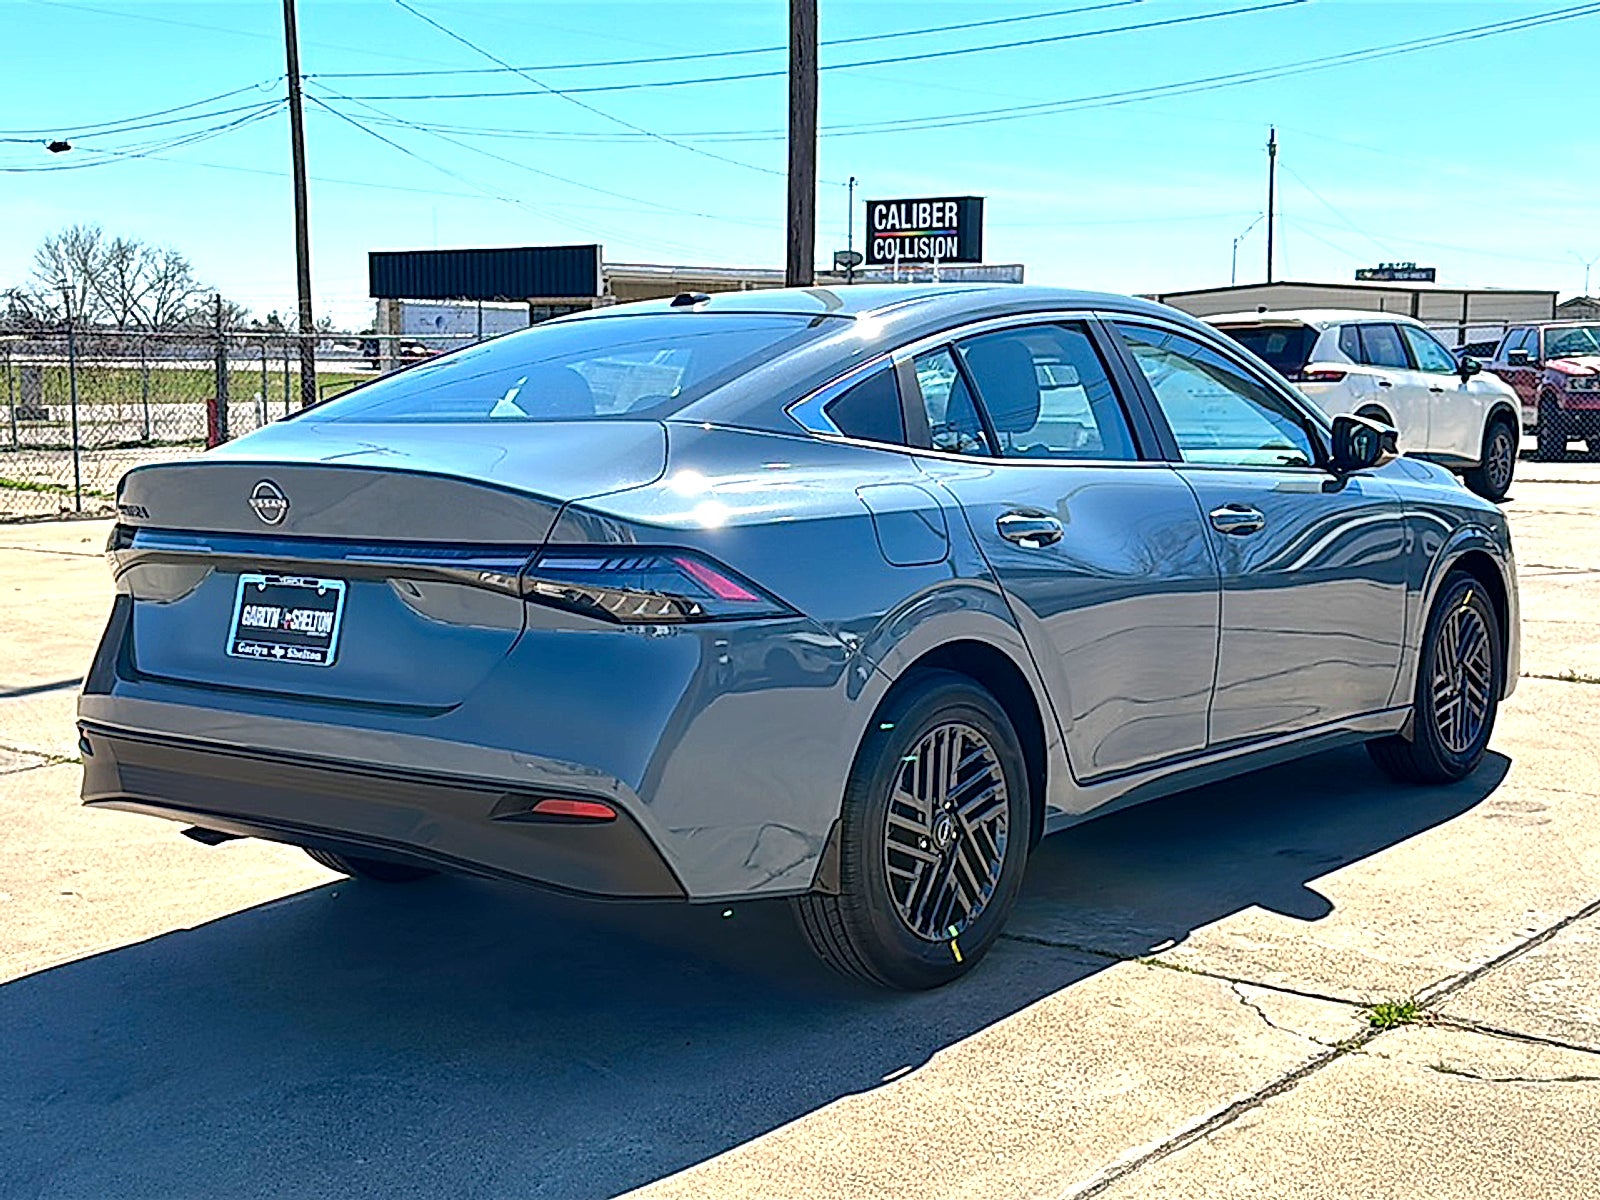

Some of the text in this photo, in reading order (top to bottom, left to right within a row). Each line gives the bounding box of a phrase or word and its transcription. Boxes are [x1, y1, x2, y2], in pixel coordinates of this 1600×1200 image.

[874, 201, 958, 230] CALIBER
[873, 236, 958, 260] COLLISION
[241, 605, 334, 633] GARLYN SHELTON
[237, 641, 322, 661] Garlyn Shelton
